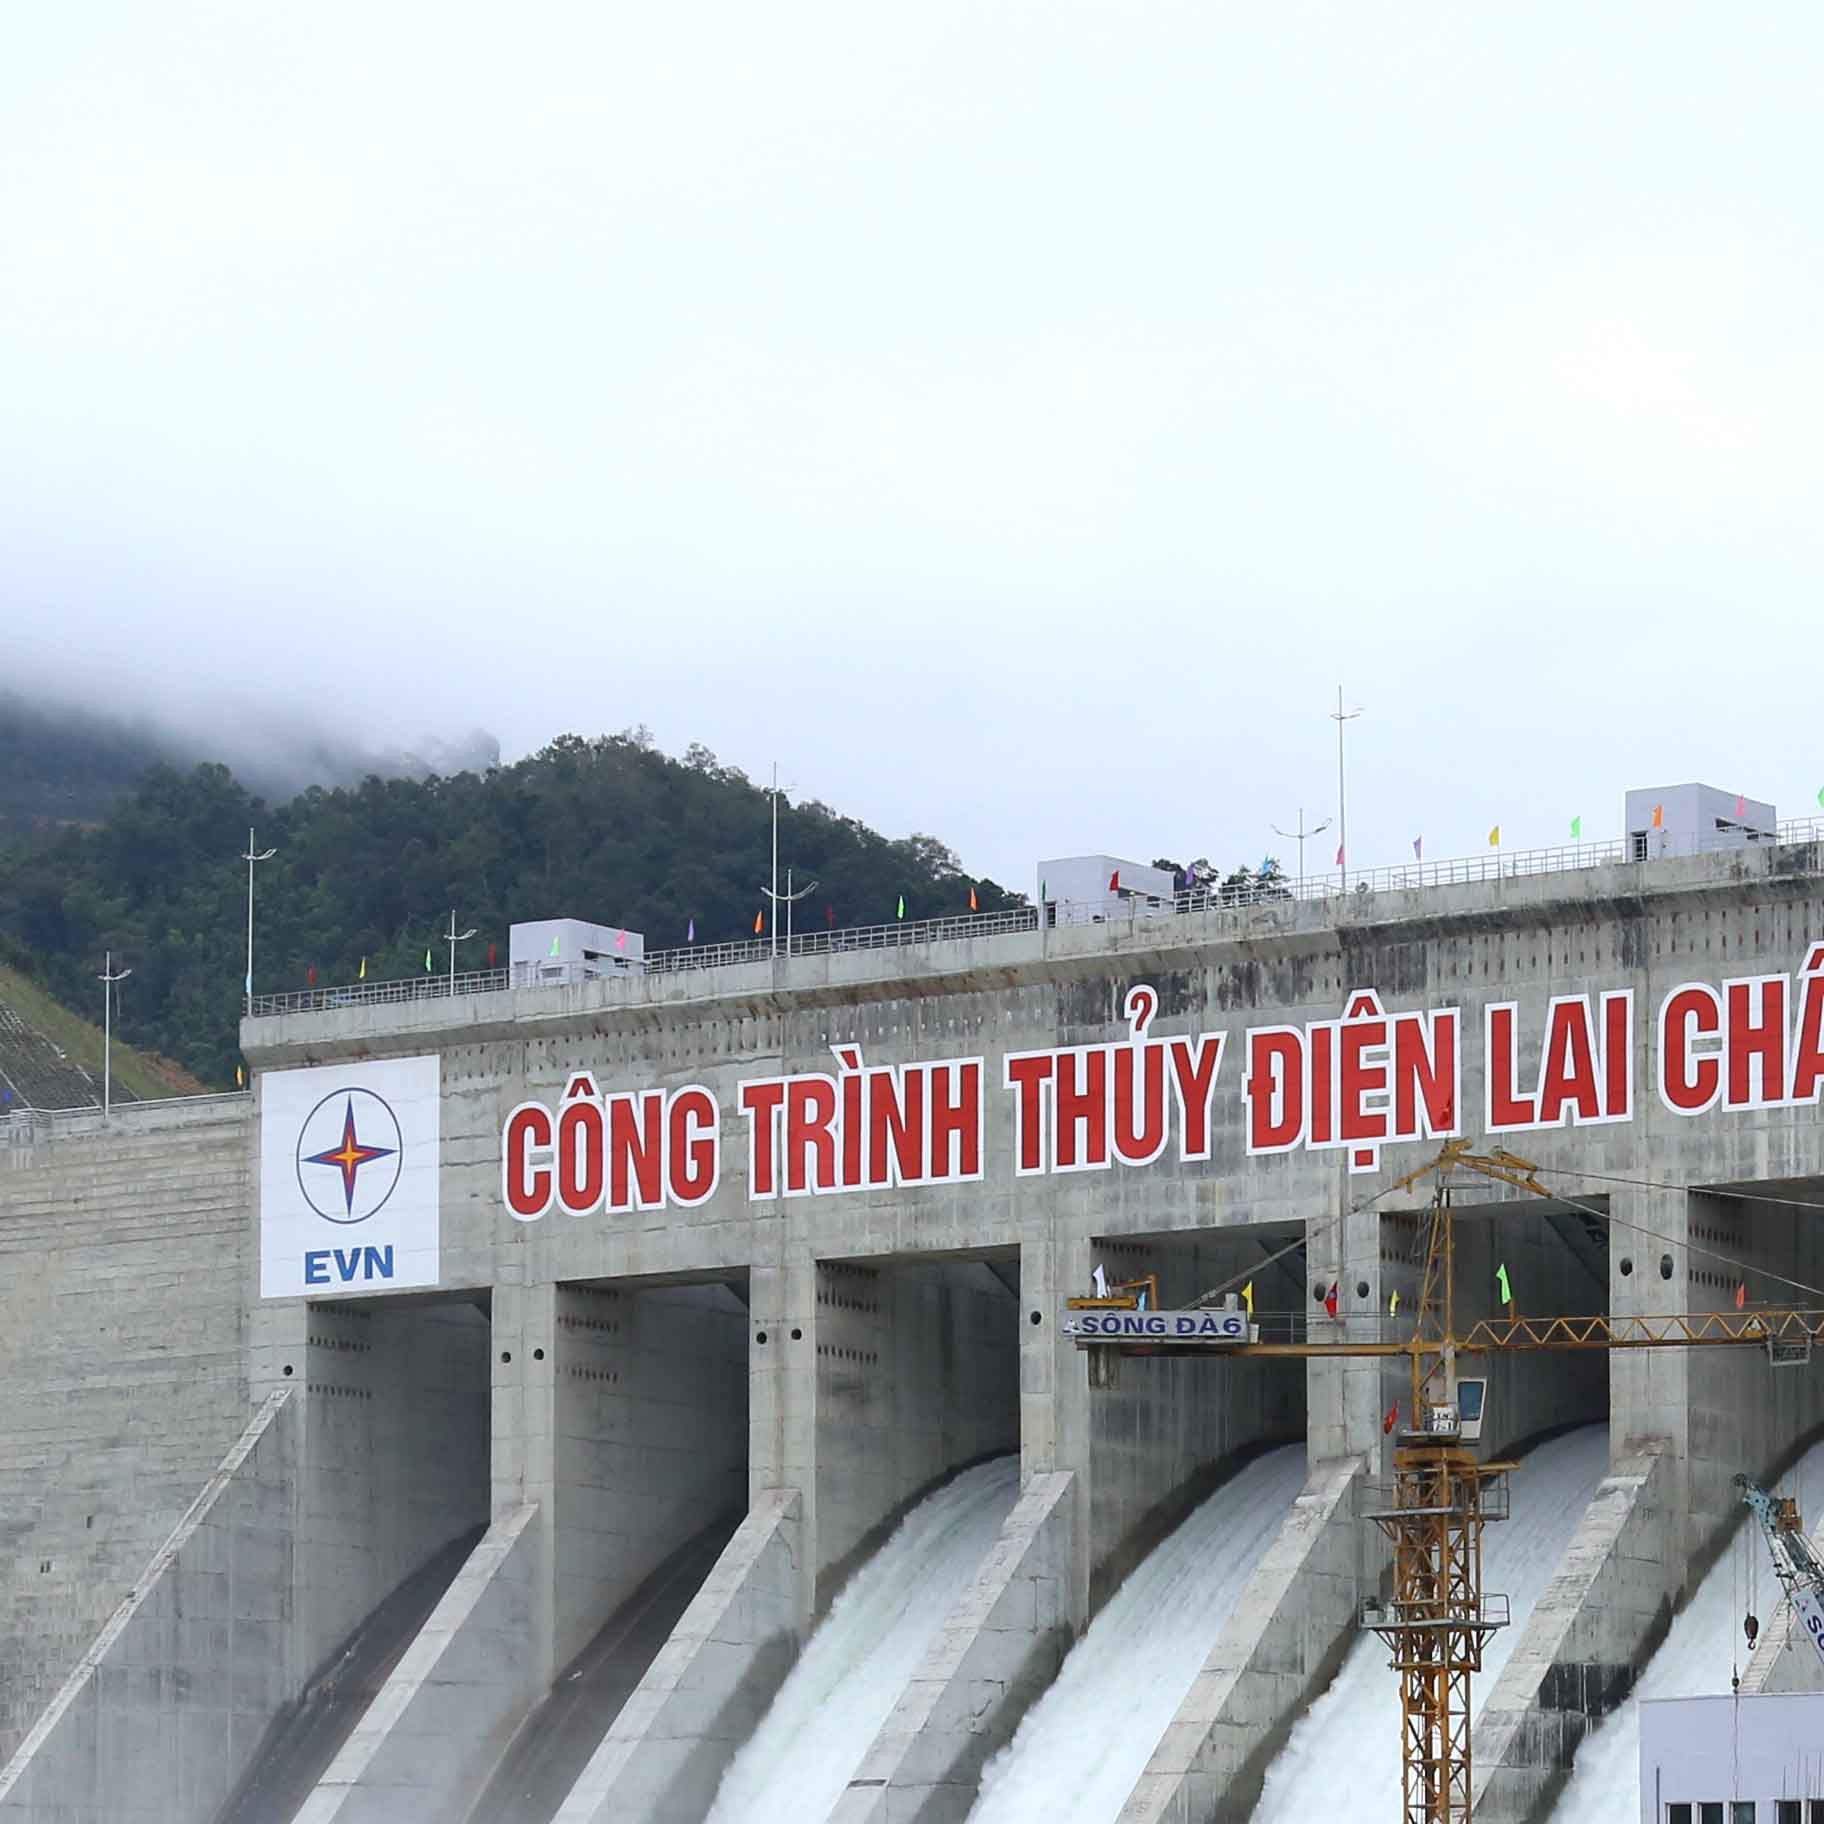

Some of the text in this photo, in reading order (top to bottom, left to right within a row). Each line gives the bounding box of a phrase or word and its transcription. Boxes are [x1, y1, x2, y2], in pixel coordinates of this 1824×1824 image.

[505, 1075, 718, 1218] CÔNG
[740, 1047, 981, 1197] TRÌNH
[1006, 988, 1222, 1173] THỦY
[1245, 992, 1458, 1170] ĐIỆN
[1488, 993, 1631, 1130] LAI
[303, 1244, 395, 1285] EVN
[1081, 1312, 1166, 1334] SÔNG
